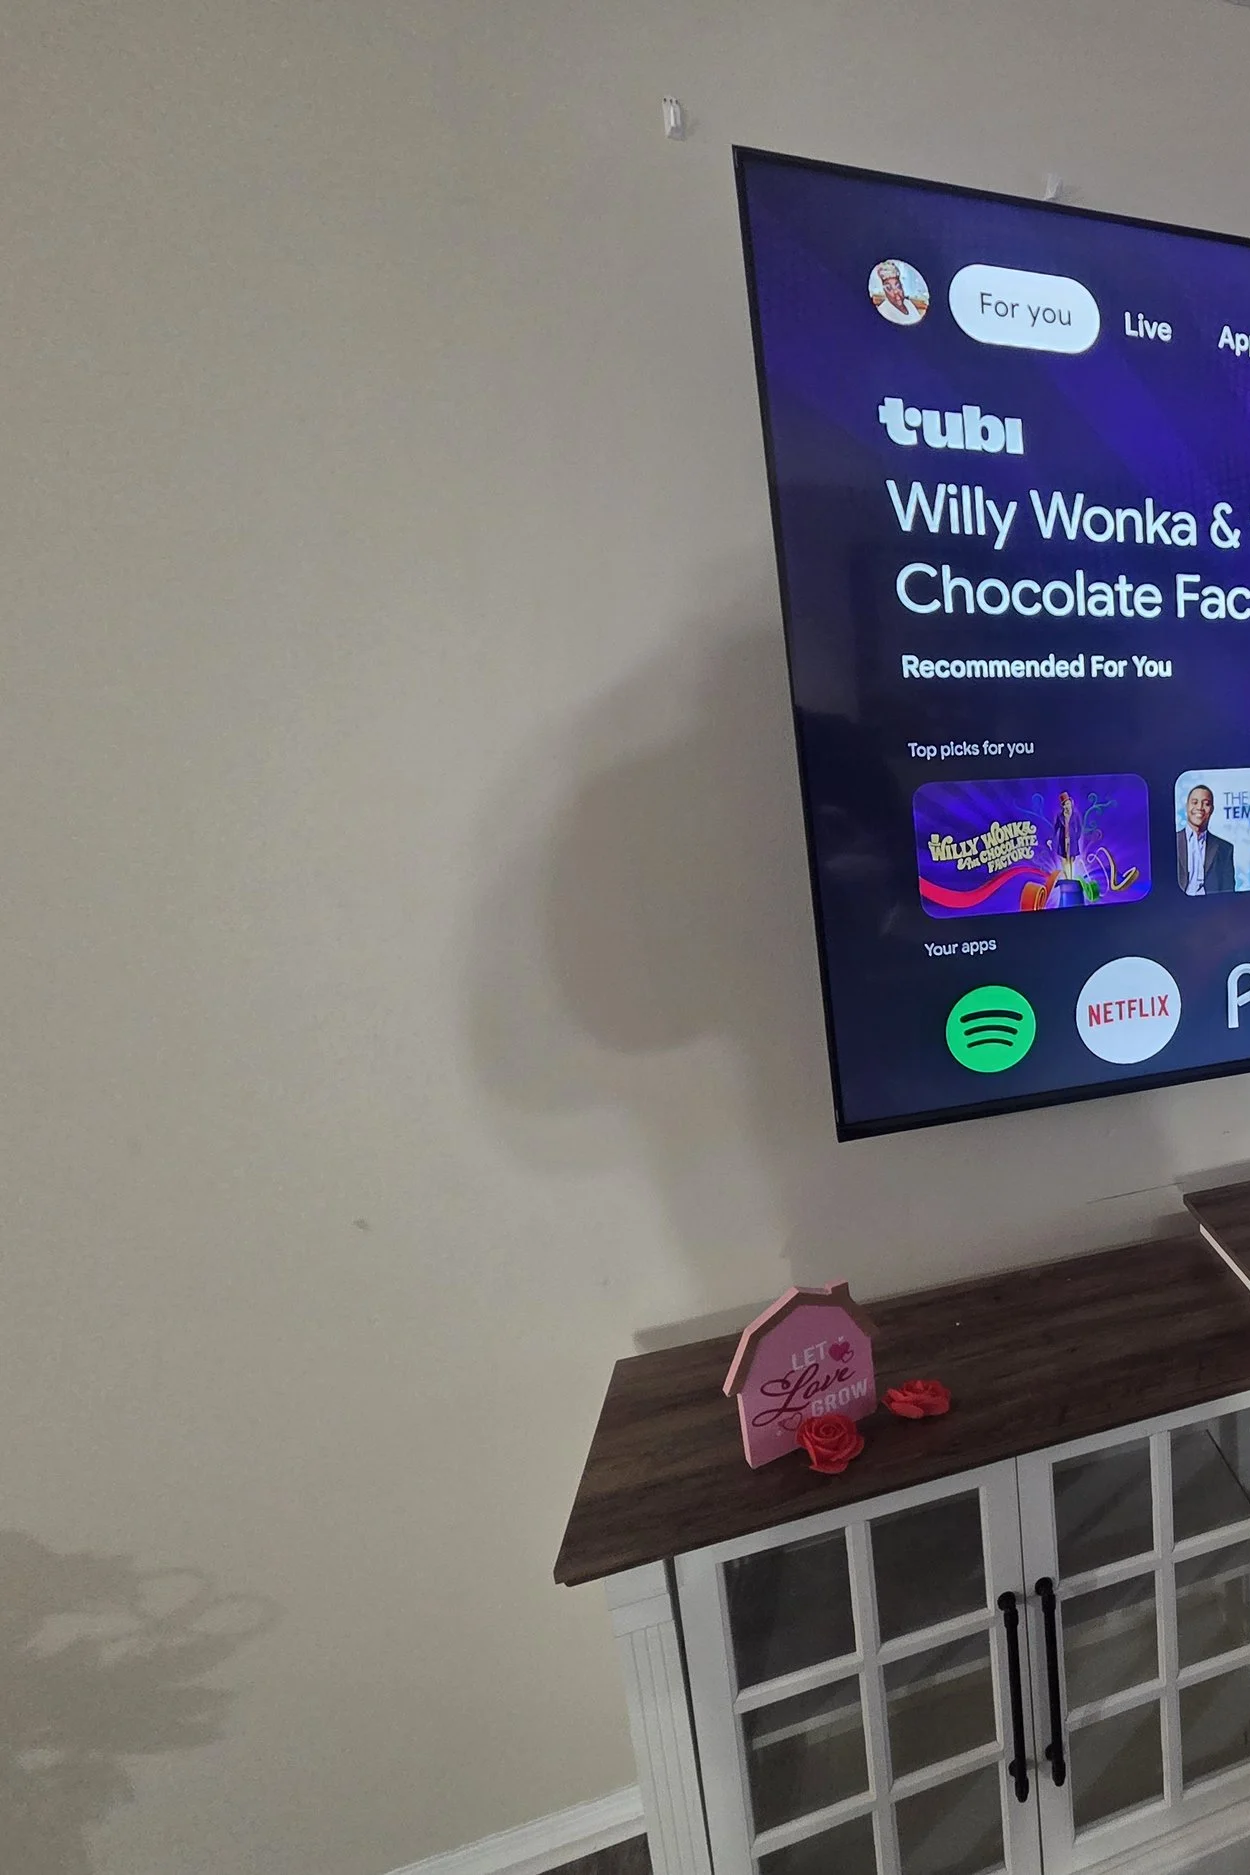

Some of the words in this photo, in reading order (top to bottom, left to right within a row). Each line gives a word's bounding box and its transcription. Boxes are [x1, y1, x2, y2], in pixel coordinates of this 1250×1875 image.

[979, 292, 1020, 319] For
[1027, 301, 1073, 328] you
[1124, 311, 1173, 343] Live
[878, 396, 1025, 456] tubi
[885, 479, 1018, 550] Willy
[1029, 489, 1198, 547] Wonka
[1209, 501, 1242, 550] &
[895, 562, 1164, 618] Chocolate
[901, 653, 1086, 679] Recommended
[1090, 655, 1128, 678] For
[1131, 655, 1173, 678] You
[907, 742, 937, 760] Top
[940, 740, 980, 760] picks
[982, 739, 1005, 756] for
[1007, 740, 1035, 759] you
[1223, 791, 1249, 806] THE
[928, 834, 979, 861] WILLY
[980, 821, 1037, 849] WONKA
[979, 835, 1039, 863] CHOCOLATE
[987, 846, 1035, 874] FACTORY
[924, 940, 958, 957] Your
[961, 938, 997, 956] apps
[1088, 994, 1170, 1027] NETFLIX
[791, 1340, 828, 1371] LET
[752, 1363, 855, 1427] Love
[811, 1378, 868, 1417] GROW
